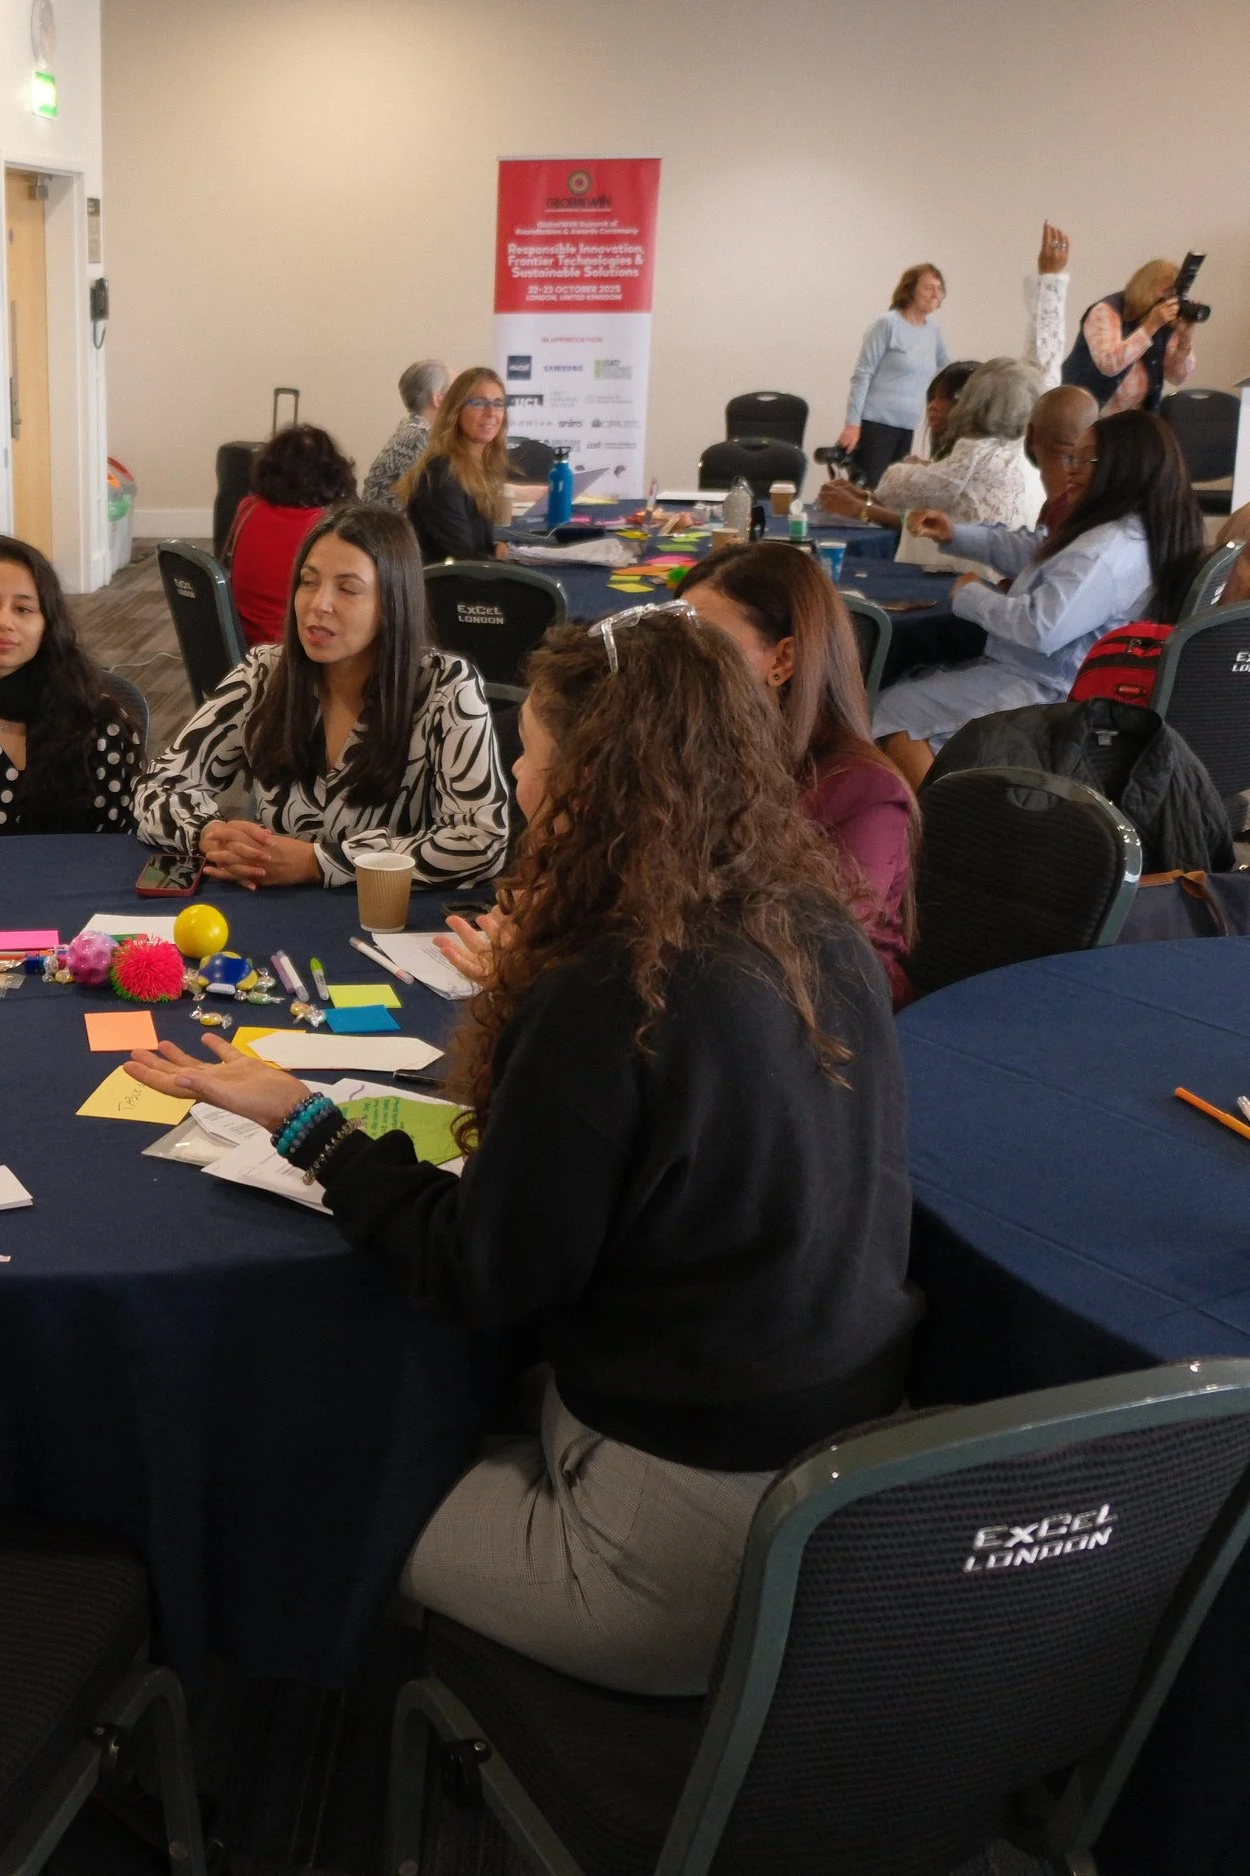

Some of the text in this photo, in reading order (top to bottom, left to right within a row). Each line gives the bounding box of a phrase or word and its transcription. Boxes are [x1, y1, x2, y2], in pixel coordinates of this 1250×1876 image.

[507, 243, 645, 257] Responsible Innovation,
[507, 253, 644, 268] Frontier Technologies &
[512, 265, 640, 278] Sustainable Solutions
[554, 285, 598, 293] OCTOBER
[458, 615, 504, 625] LONDON
[962, 1526, 1113, 1574] LONDON
